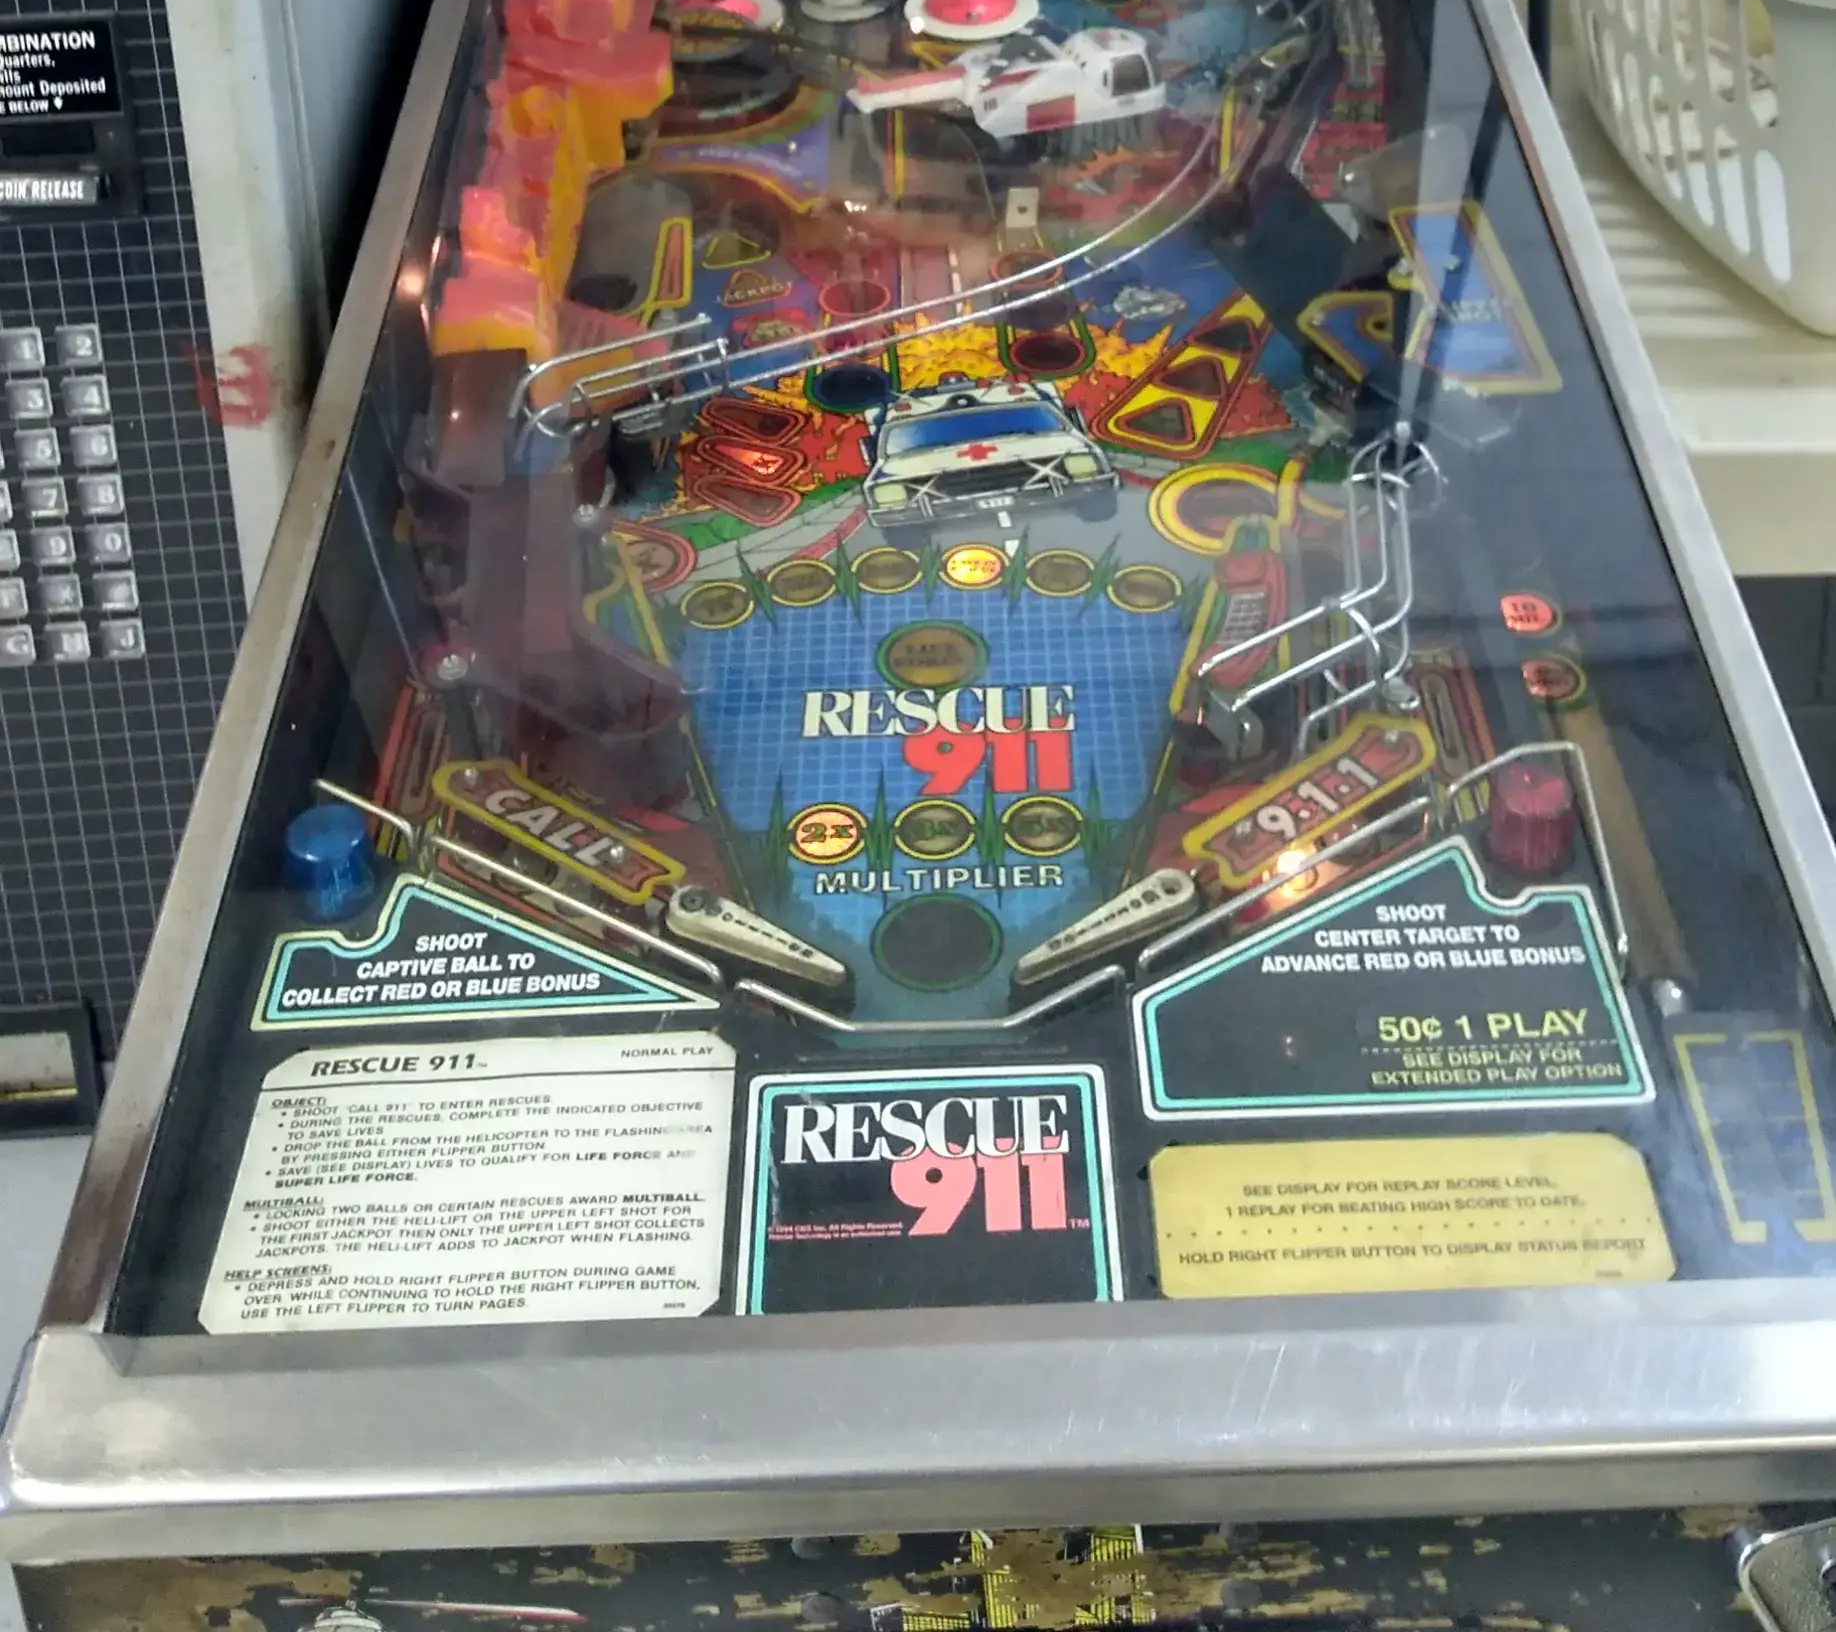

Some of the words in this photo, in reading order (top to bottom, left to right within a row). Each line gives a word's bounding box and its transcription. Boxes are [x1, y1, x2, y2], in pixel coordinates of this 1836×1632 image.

[39, 77, 106, 97] Deposited
[8, 99, 49, 114] BELOW
[31, 180, 84, 200] RELEASE
[75, 335, 93, 356] 2
[27, 388, 44, 409] 3
[42, 488, 57, 508] 7
[803, 684, 1075, 738] RESCUE
[902, 718, 1074, 796] 911
[485, 789, 615, 867] CALL
[815, 865, 1064, 895] MULTIPLIER
[1376, 904, 1445, 921] SHOOT
[414, 932, 487, 951] SHOOT
[1315, 928, 1400, 946] CENTER
[1404, 926, 1485, 944] TARGET
[1490, 925, 1519, 941] TO
[355, 958, 447, 978] CAPTIVE
[450, 954, 504, 972] BALL
[507, 952, 536, 970] TO
[1262, 953, 1359, 972] ADVANCE
[1364, 952, 1409, 969] RED
[1413, 950, 1445, 967] OR
[1449, 948, 1506, 966] BLUE
[1509, 946, 1586, 964] BONUS
[281, 985, 378, 1006] COLLECT
[380, 982, 428, 1000] RED
[429, 980, 462, 997] OR
[464, 977, 522, 995] BLUE
[525, 972, 600, 992] BONUS
[1455, 1015, 1472, 1040] 1
[1487, 1008, 1588, 1039] PLAY
[620, 1048, 677, 1056] NORMAL
[1402, 1053, 1442, 1066] SEE
[1448, 1050, 1532, 1065] DISPLAY
[1538, 1048, 1581, 1061] FOR
[310, 1056, 419, 1075] RESCUE
[428, 1054, 475, 1070] 911
[1371, 1069, 1481, 1084] EXTENDED
[1486, 1067, 1538, 1081] PLAY
[1544, 1064, 1621, 1078] OPTION
[289, 1117, 342, 1128] DURING
[347, 1115, 373, 1124] THE
[448, 1108, 518, 1120] COMPLETE
[556, 1104, 626, 1114] INDICATED
[630, 1102, 702, 1111] OBJECTIVE
[286, 1128, 305, 1139] TO
[308, 1129, 341, 1138] SAVE
[346, 1127, 384, 1135] LIVES
[781, 1094, 1070, 1164] RESCUE
[280, 1155, 299, 1164] BY
[302, 1151, 372, 1164] PRESSING
[376, 1147, 426, 1158] EITHER
[431, 1145, 485, 1155] FLIPPER
[274, 1177, 323, 1188] SUPER
[328, 1174, 360, 1183] LIFE
[891, 1136, 1068, 1237] 911
[1242, 1185, 1272, 1196] SEE
[1276, 1183, 1340, 1194] DISPLAY
[1346, 1181, 1377, 1192] FOR
[1382, 1180, 1440, 1191] REPLAY
[1446, 1178, 1500, 1188] SCORE
[263, 1205, 326, 1218] LOCKING
[331, 1205, 361, 1213] TWO
[365, 1203, 408, 1212] BALLS
[437, 1201, 494, 1211] CERTAIN
[500, 1197, 563, 1206] RESCUES
[569, 1195, 617, 1204] AWARD
[1238, 1204, 1295, 1216] REPLAY
[1301, 1203, 1333, 1213] FOR
[1338, 1201, 1405, 1213] BEATING
[1410, 1200, 1450, 1211] HIGH
[1454, 1197, 1508, 1209] SCORE
[1516, 1197, 1535, 1206] TO
[1178, 1251, 1224, 1264] HOLD
[1228, 1249, 1275, 1261] RIGHT
[1282, 1247, 1345, 1258] FLIPPER
[1351, 1245, 1416, 1257] BUTTON
[1422, 1245, 1442, 1254] TO
[1446, 1242, 1511, 1254] DISPLAY
[1518, 1240, 1577, 1251] STATUS
[223, 1269, 262, 1281] HELP
[247, 1278, 312, 1291] DEPRESS
[316, 1278, 348, 1290] AND
[352, 1276, 394, 1289] HOLD
[398, 1275, 441, 1285] RIGHT
[448, 1272, 505, 1283] FLIPPER
[510, 1268, 567, 1279] BUTTON
[572, 1266, 629, 1276] DURING
[634, 1266, 676, 1276] GAME
[288, 1291, 333, 1304] WHILE
[337, 1287, 429, 1301] CONTINUING
[432, 1288, 451, 1297] TO
[455, 1286, 494, 1296] HOLD
[499, 1284, 525, 1293] THE
[530, 1281, 572, 1291] RIGHT
[578, 1279, 636, 1290] FLIPPER
[240, 1308, 268, 1318] USE
[275, 1306, 301, 1315] THE
[307, 1303, 340, 1313] LEFT
[346, 1301, 406, 1314] FLIPPER
[411, 1303, 429, 1312] TO
[434, 1301, 473, 1311] TURN
